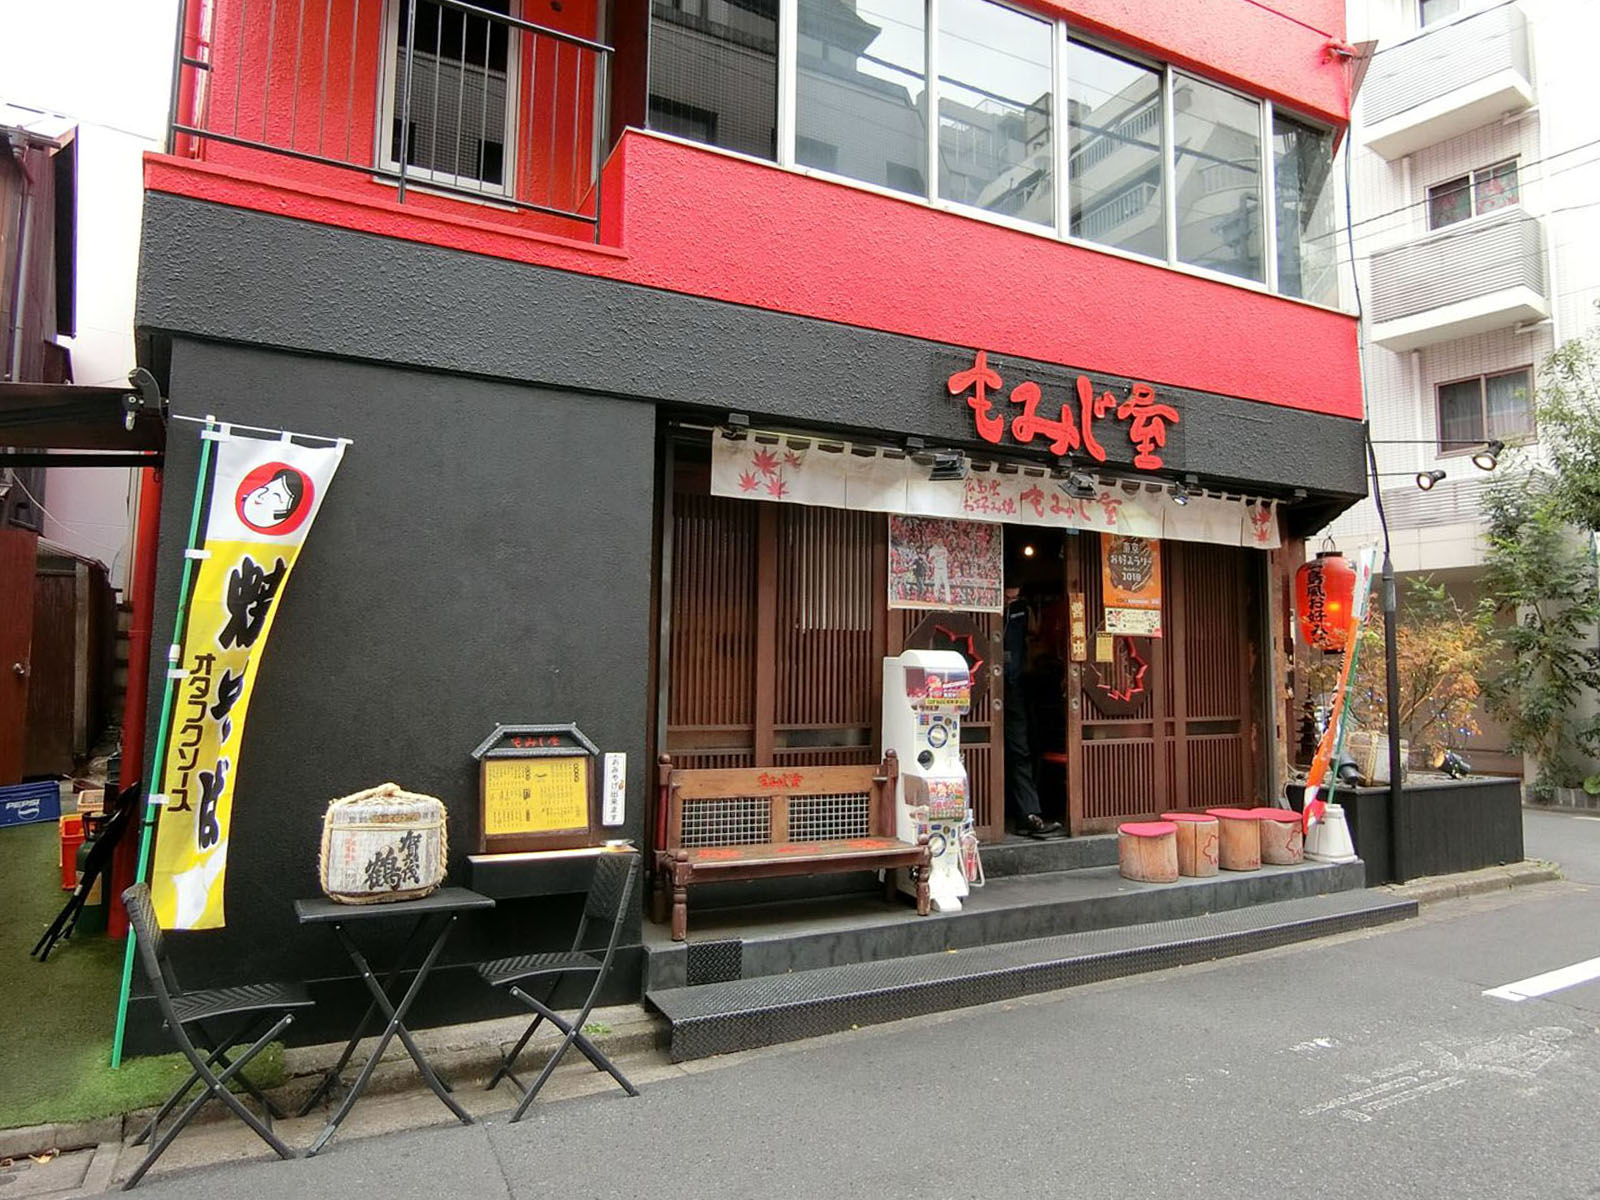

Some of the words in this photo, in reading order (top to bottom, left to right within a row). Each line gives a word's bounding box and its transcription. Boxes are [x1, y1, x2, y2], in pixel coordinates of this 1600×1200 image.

[948, 350, 1180, 470] もみじ屋
[167, 653, 216, 812] オタフクソース
[5, 798, 41, 810] PEPSI
